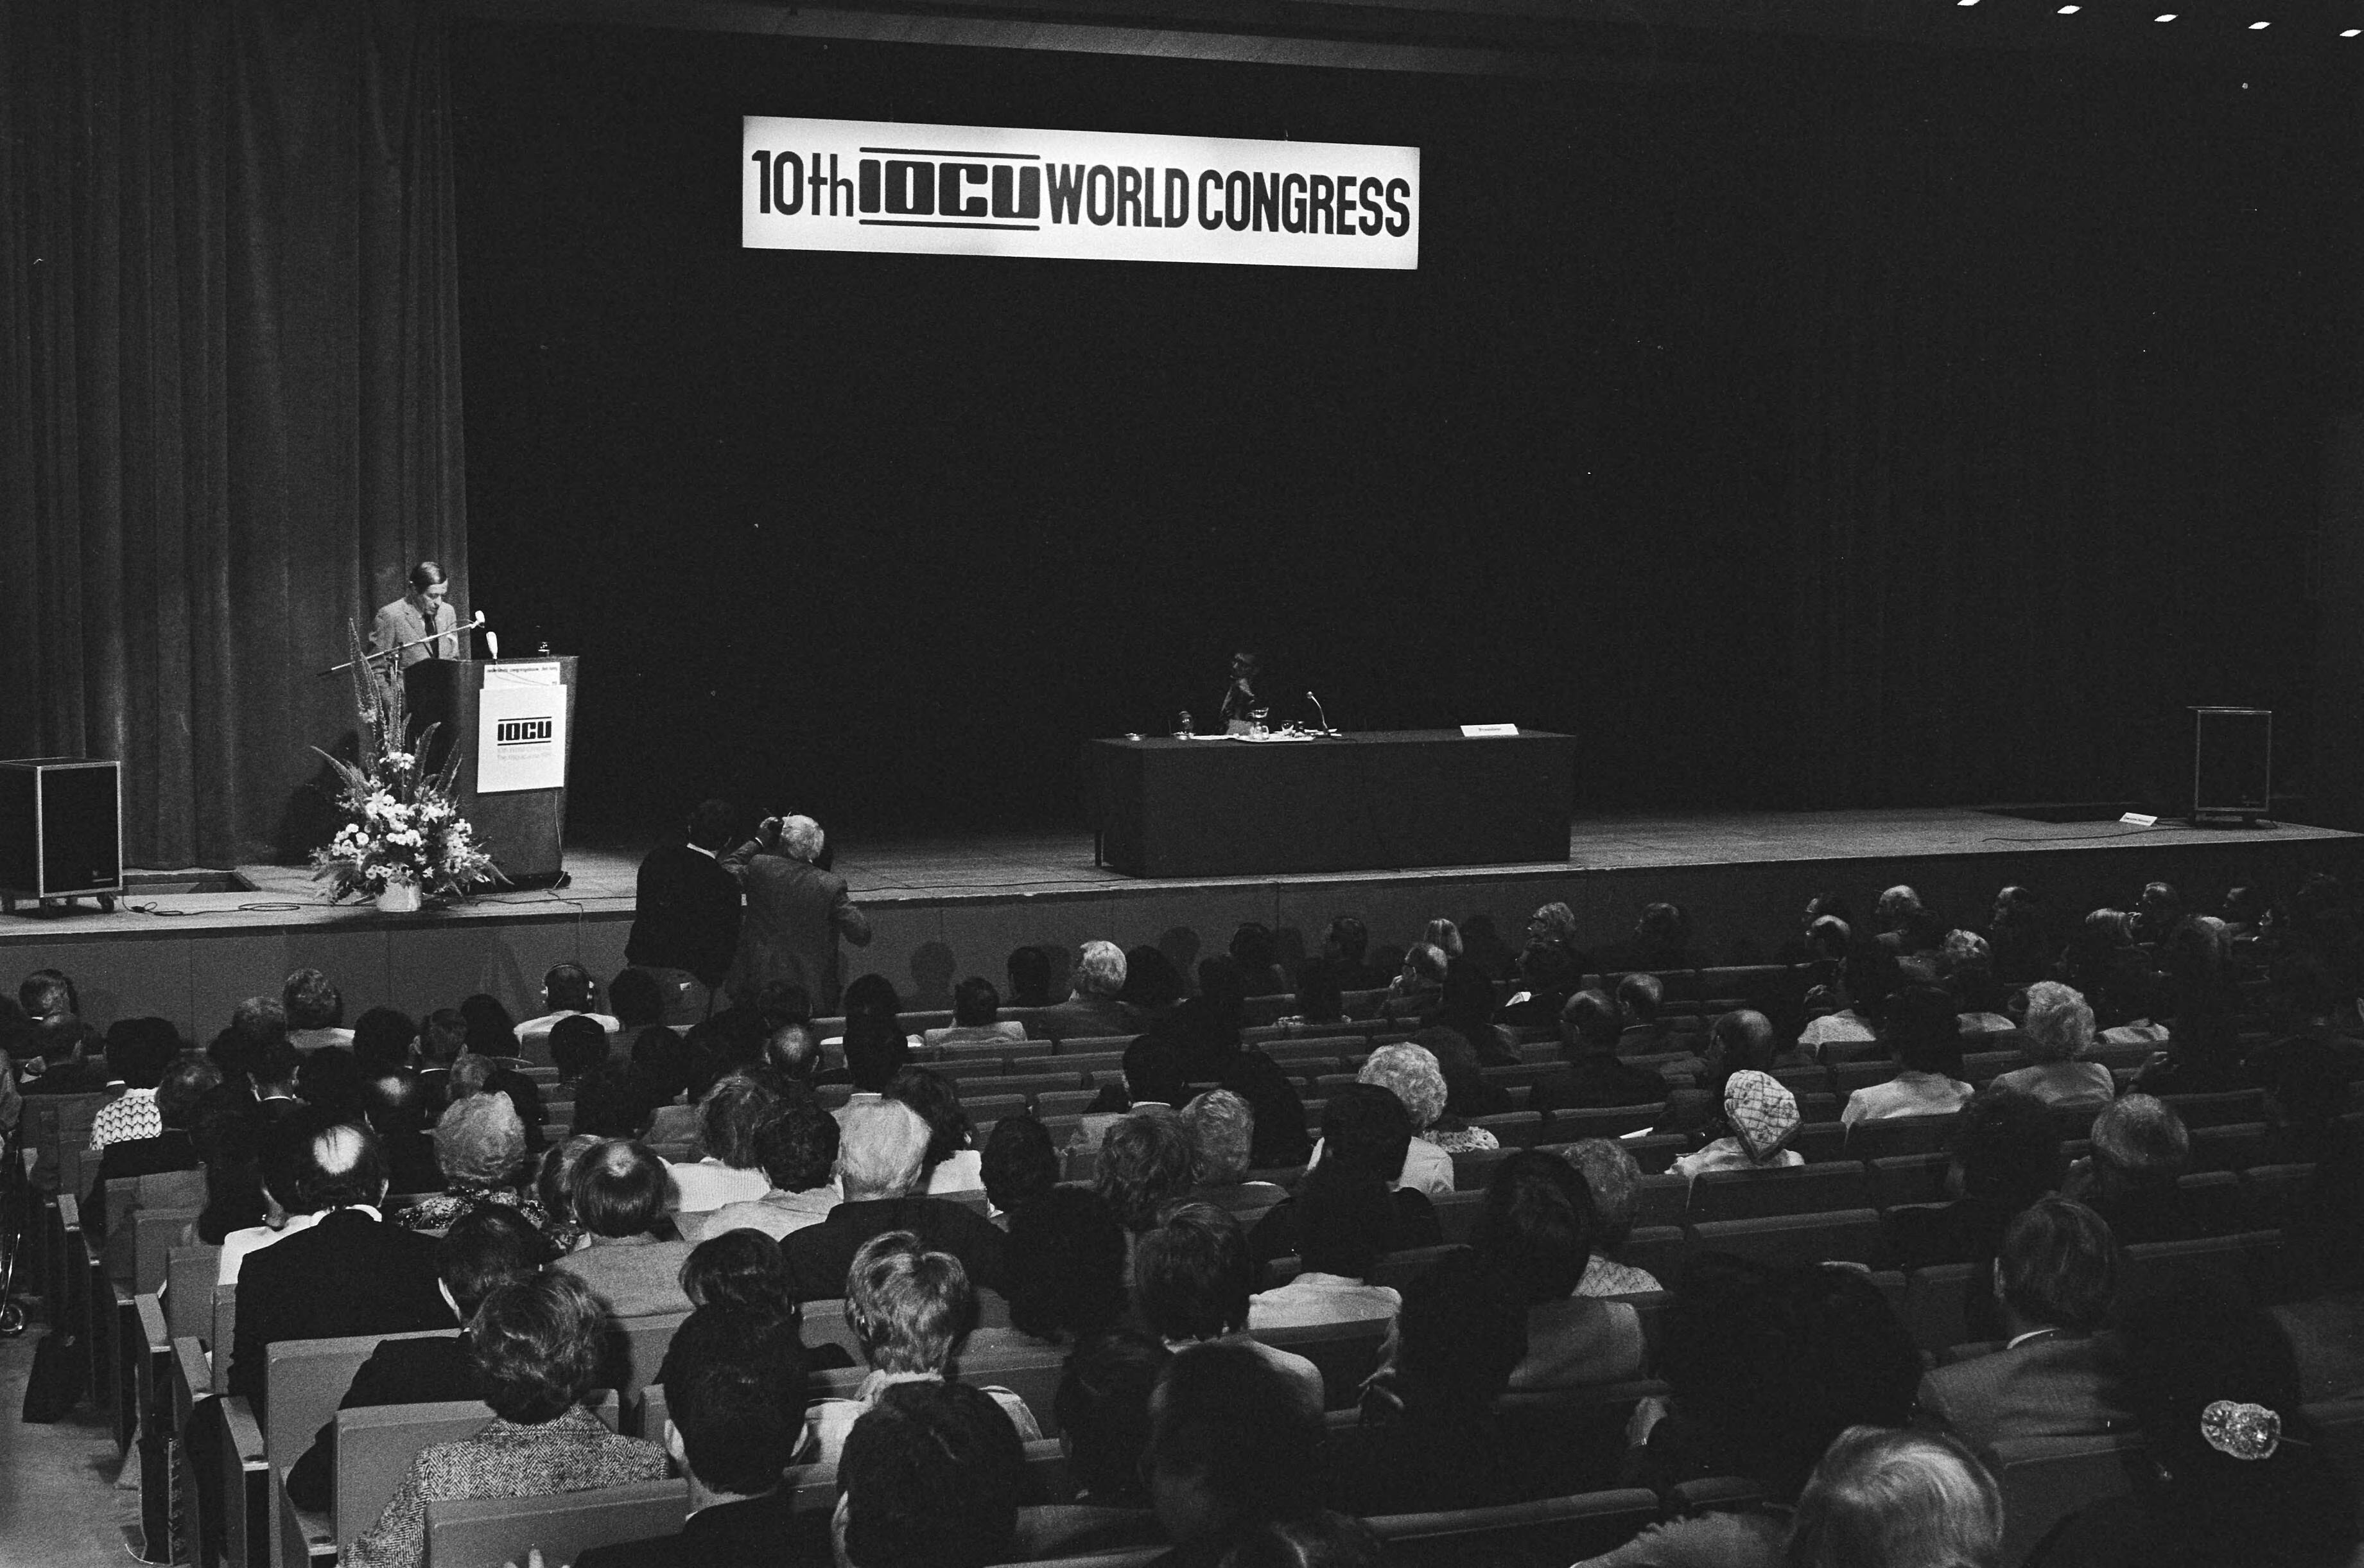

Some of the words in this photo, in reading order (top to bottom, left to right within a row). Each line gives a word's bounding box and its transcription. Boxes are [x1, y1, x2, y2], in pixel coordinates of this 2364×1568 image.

[751, 150, 854, 217] 10th
[858, 159, 1041, 219] IOCU
[1045, 163, 1190, 228] WORLD
[1197, 169, 1411, 238] CONGRESS
[497, 720, 552, 742] IOCU
